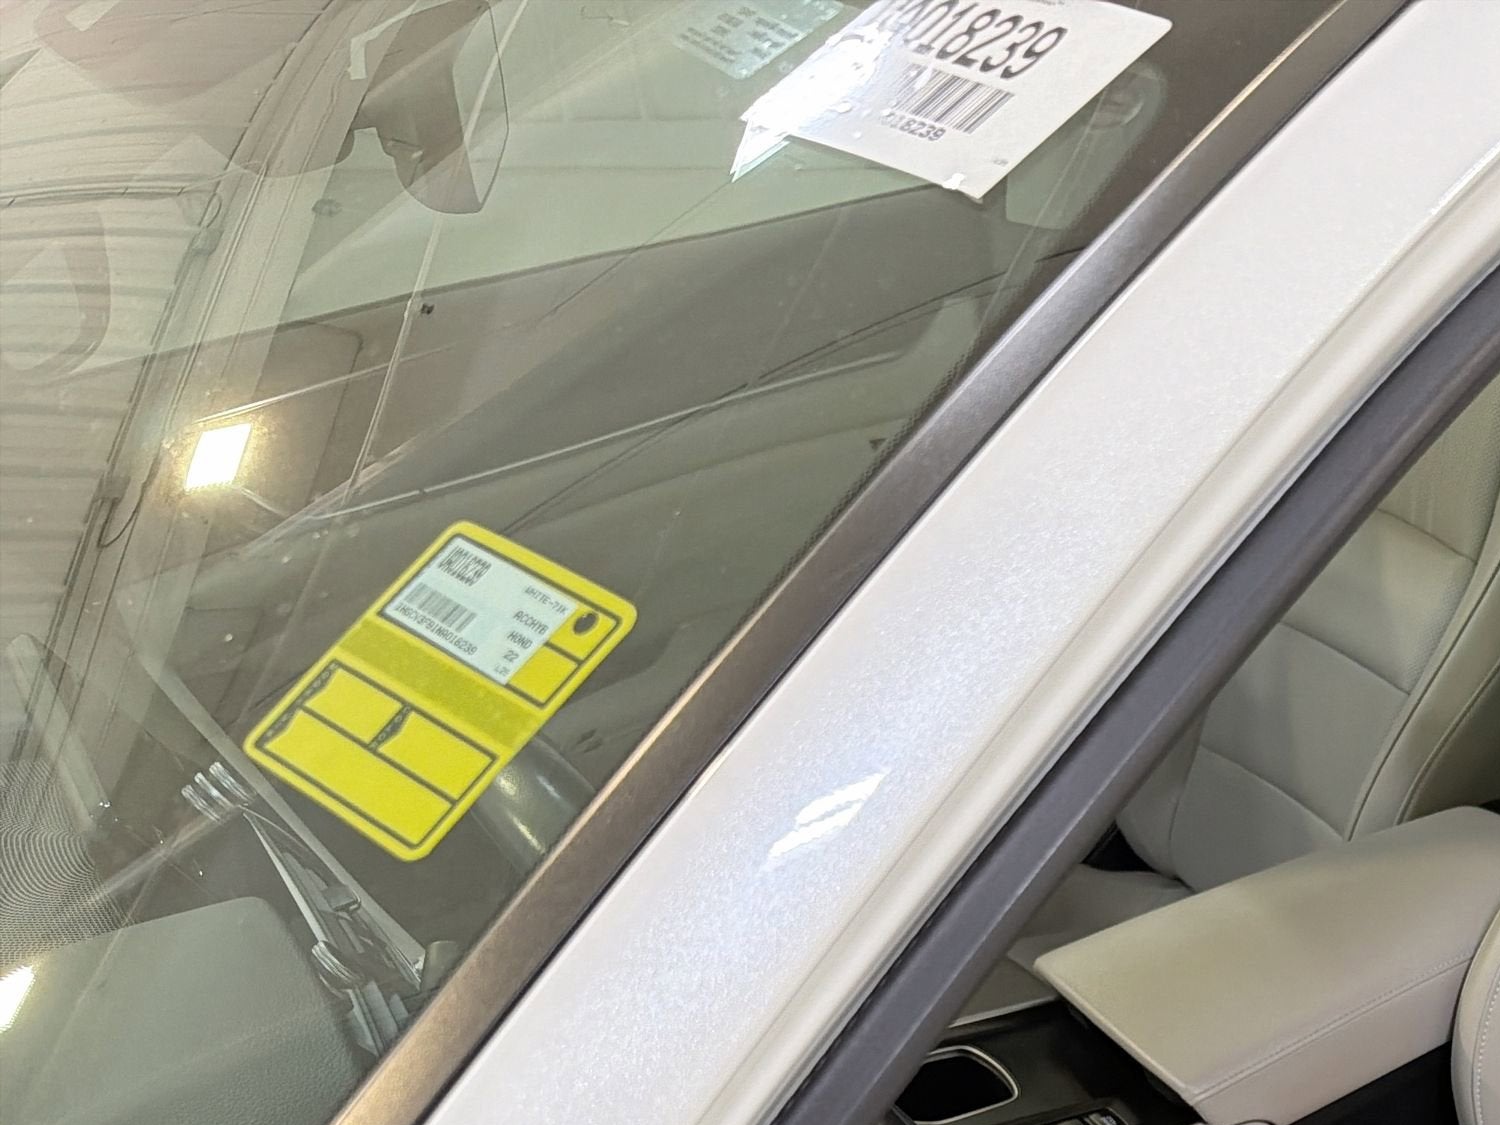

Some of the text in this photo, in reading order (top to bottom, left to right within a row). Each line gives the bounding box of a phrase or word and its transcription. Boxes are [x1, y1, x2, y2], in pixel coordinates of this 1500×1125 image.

[512, 610, 549, 635] ACCHYB
[507, 630, 533, 649] HOND
[502, 650, 519, 663] 22
